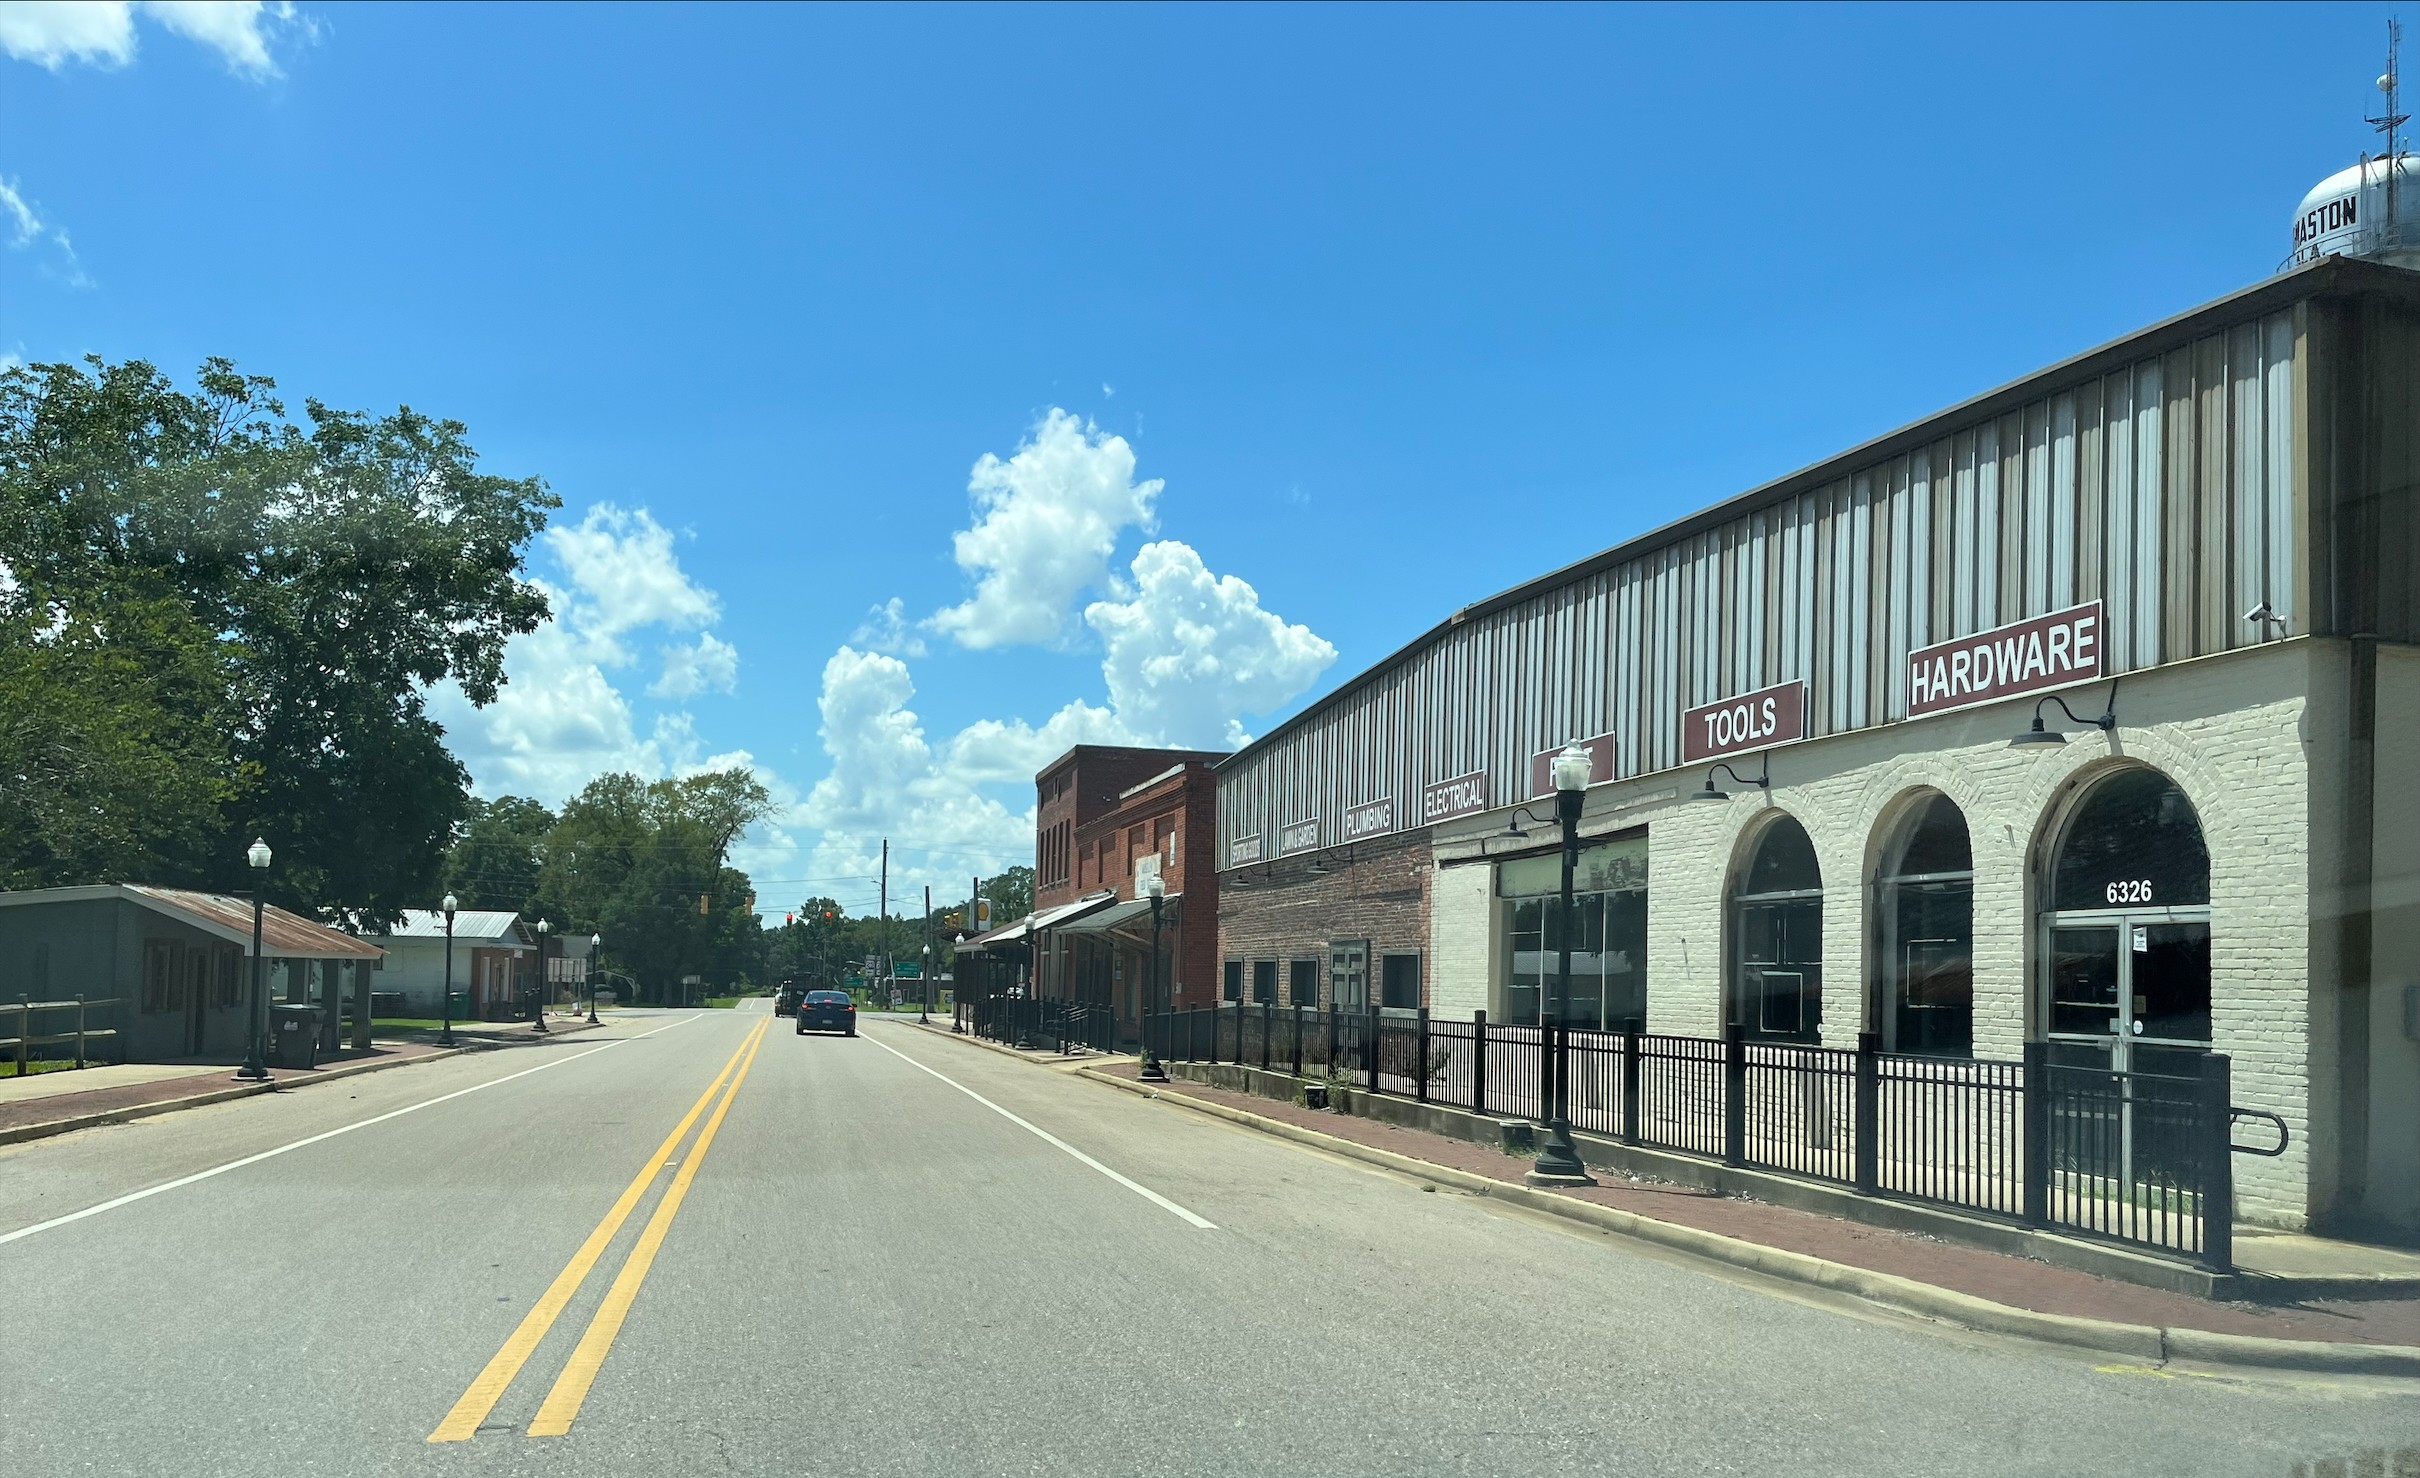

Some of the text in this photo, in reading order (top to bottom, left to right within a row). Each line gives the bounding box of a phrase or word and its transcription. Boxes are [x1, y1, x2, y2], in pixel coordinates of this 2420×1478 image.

[1911, 616, 2096, 706] HARDWARE
[1704, 697, 1777, 749] TOOLS
[1426, 779, 1483, 817] ELECTRICAL
[1346, 803, 1390, 836] PLUMBING
[2106, 879, 2152, 904] 6326
